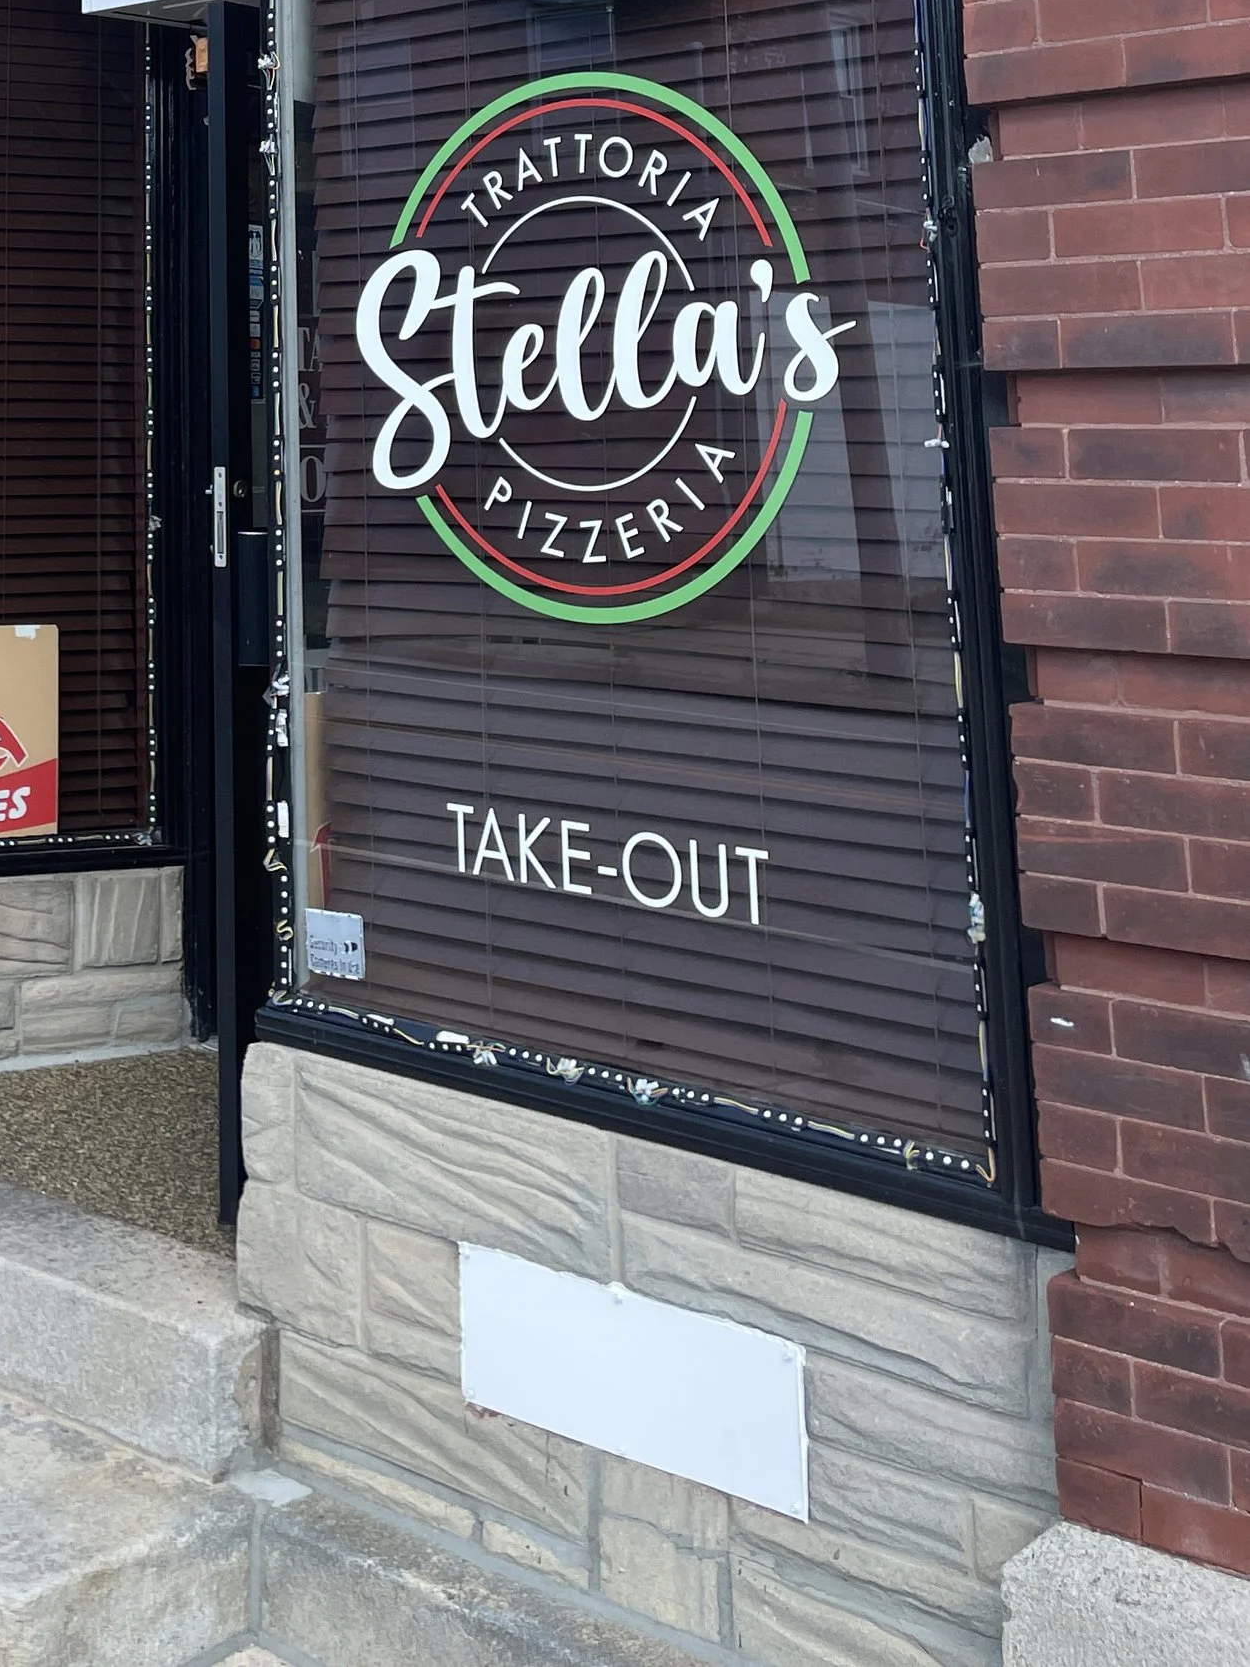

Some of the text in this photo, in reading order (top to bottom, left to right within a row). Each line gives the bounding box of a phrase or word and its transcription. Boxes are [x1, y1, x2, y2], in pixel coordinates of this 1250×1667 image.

[461, 133, 720, 241] TRATTORIA
[356, 249, 857, 489] Stella's
[484, 443, 736, 563] PIZZERIA
[447, 803, 769, 925] TAKE-OUT
